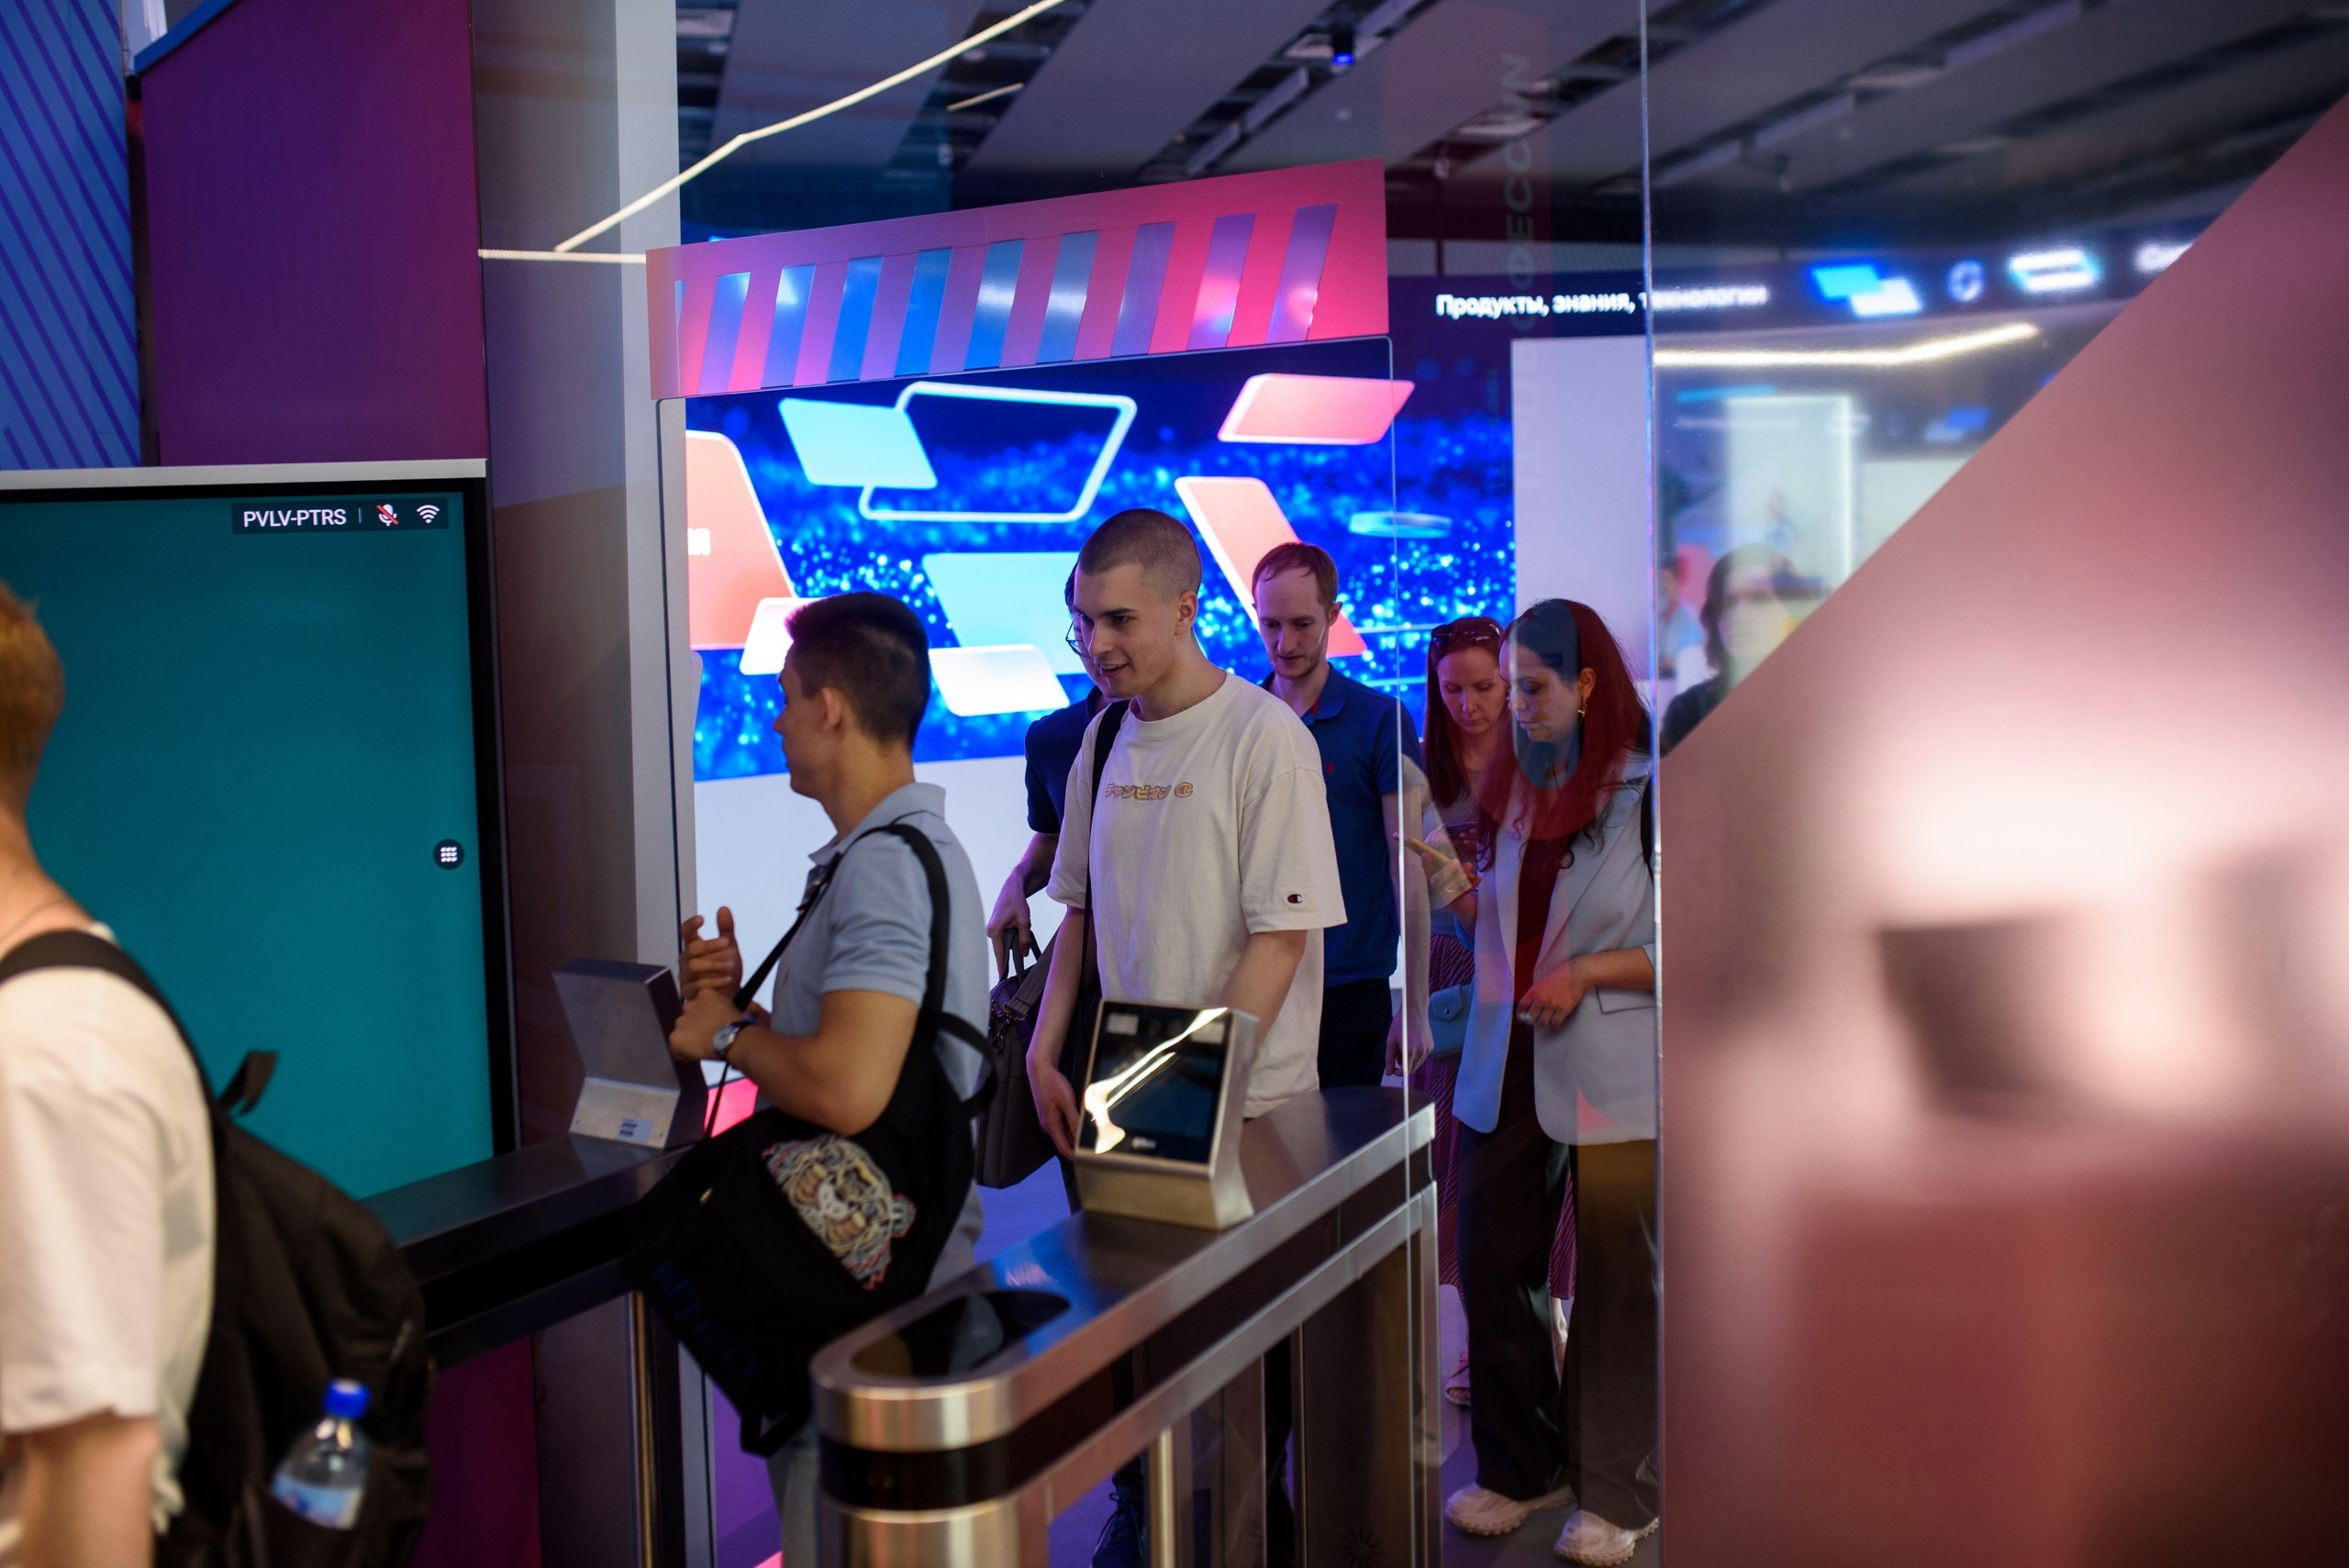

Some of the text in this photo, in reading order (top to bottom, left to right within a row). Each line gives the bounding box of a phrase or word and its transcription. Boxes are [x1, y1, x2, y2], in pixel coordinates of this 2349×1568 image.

[1436, 294, 1550, 320] Продукты,
[1552, 293, 1636, 315] знания,
[243, 508, 347, 528] PVLV-PTRS
